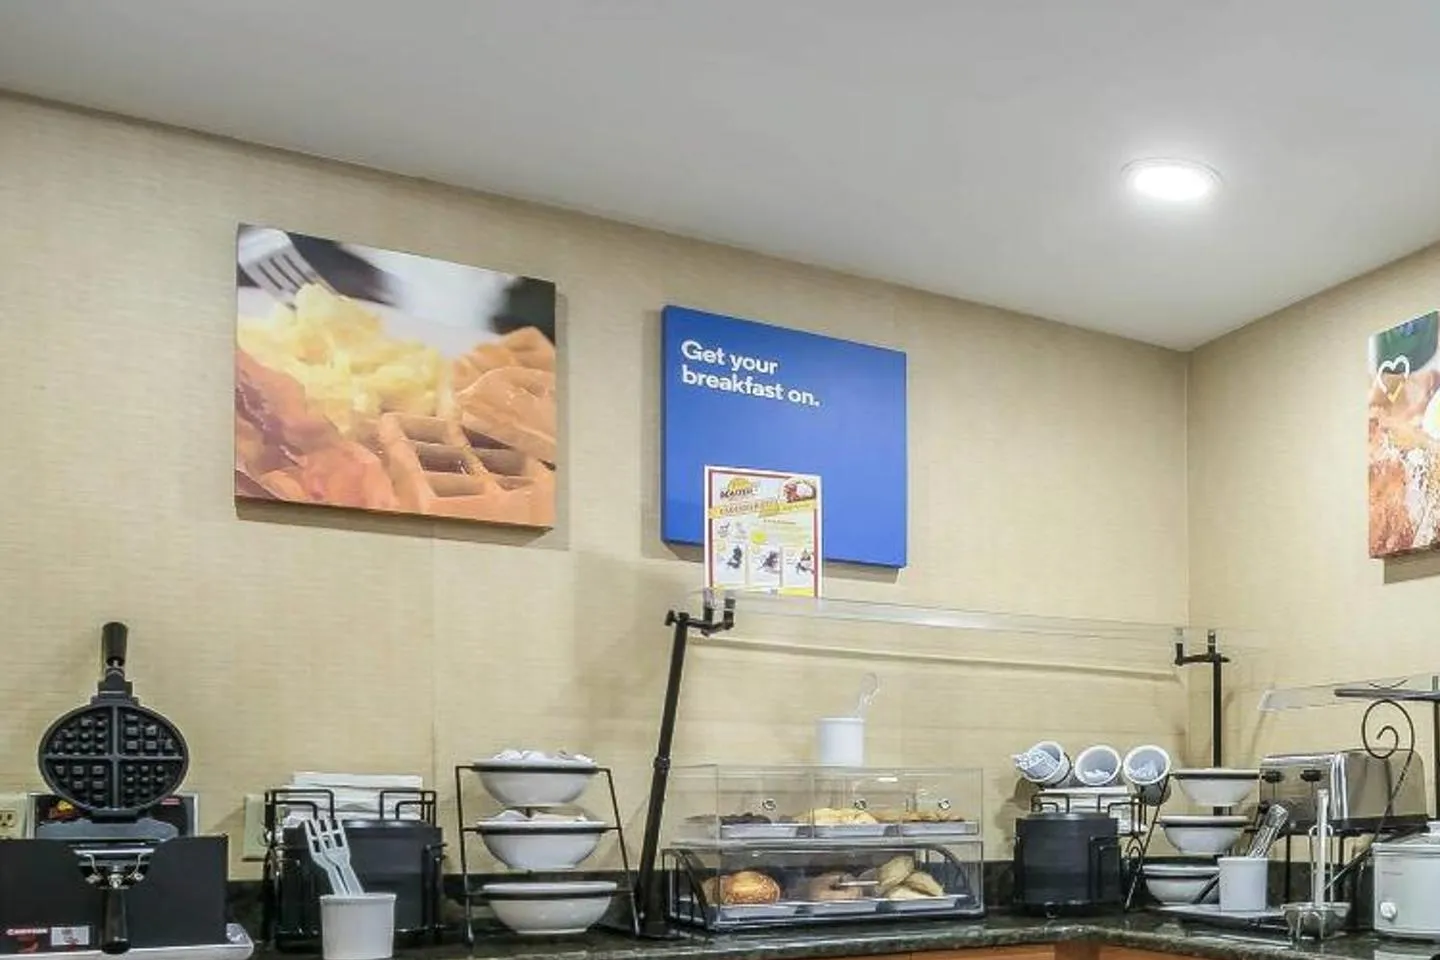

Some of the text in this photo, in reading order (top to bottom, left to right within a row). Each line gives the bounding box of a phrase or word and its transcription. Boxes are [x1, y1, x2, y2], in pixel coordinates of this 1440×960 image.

[681, 339, 779, 375] Get your
[681, 363, 821, 407] breakfast on.
